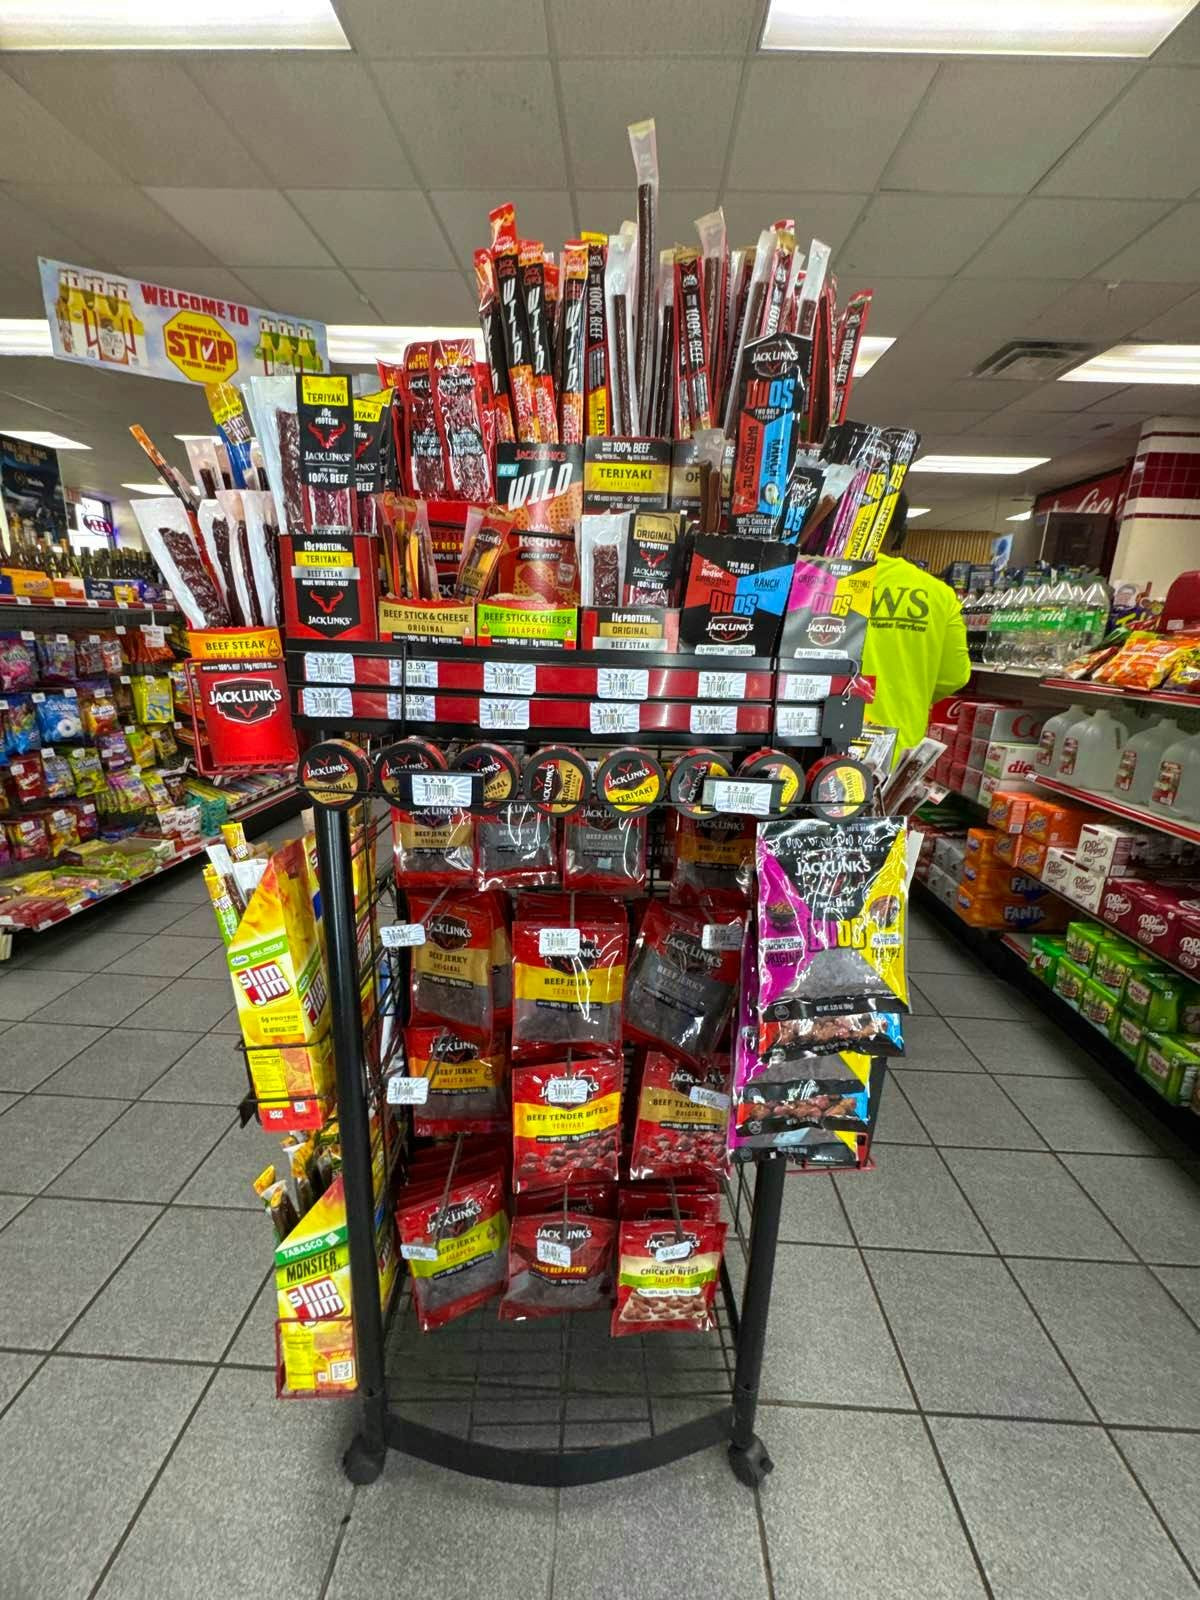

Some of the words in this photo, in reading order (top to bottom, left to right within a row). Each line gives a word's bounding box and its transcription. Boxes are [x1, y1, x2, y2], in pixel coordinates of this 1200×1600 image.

[141, 284, 226, 319] WELCOME
[227, 304, 249, 326] TO
[177, 323, 222, 338] COMPLETE
[589, 316, 603, 339] BEEF
[167, 330, 234, 366] STOP
[689, 340, 704, 365] BEEF
[752, 352, 772, 364] JACK
[307, 392, 345, 404] TERIYAKI
[355, 411, 376, 420] IYAKI
[613, 442, 631, 454] 100%
[632, 442, 651, 454] BEEF
[308, 473, 329, 484] 100%
[330, 473, 349, 485] BEEF
[600, 467, 652, 480] TERIYAKI
[357, 483, 374, 492] BEEF
[508, 462, 573, 510] WILD
[866, 472, 886, 499] OS
[784, 507, 806, 532] OS
[636, 529, 672, 541] ORIGINAL
[315, 542, 341, 551] PROTEIN
[646, 542, 669, 551] PROTEIN
[306, 555, 341, 564] TERIYAKI
[740, 561, 755, 570] BOLD
[651, 581, 664, 589] BEEF
[754, 577, 780, 589] RANCH
[710, 588, 759, 616] DUOS
[811, 592, 853, 617] DUOS
[870, 586, 930, 619] WS
[308, 615, 327, 625] JACK
[383, 608, 402, 618] BEEF
[404, 610, 428, 620] STICK
[429, 612, 436, 620] &
[437, 613, 469, 622] CHEESE
[484, 612, 504, 620] BEEF
[506, 613, 531, 622] STICK
[531, 615, 538, 623] &
[540, 615, 572, 624] CHEESE
[623, 613, 651, 623] PROTEIN
[407, 623, 444, 633] ORIGINAL
[612, 626, 649, 635] ORIGINAL
[706, 621, 728, 631] JACK
[806, 623, 825, 633] JACK
[205, 641, 231, 651] BEEF
[231, 640, 266, 649] STEAK
[611, 640, 627, 649] BEEF
[629, 640, 650, 649] STEAK
[407, 661, 426, 670] 3.59
[209, 690, 242, 705] JACK
[406, 695, 425, 703] 3.59
[307, 767, 326, 778] JACK
[608, 775, 628, 789] JACK
[616, 787, 654, 803] TERIYAKI
[582, 808, 602, 818] JACK
[663, 934, 689, 953] JACK
[444, 953, 468, 963] JERKY
[238, 963, 286, 990] slim
[544, 977, 566, 985] BEEF
[678, 972, 705, 992] JERKY
[669, 1072, 694, 1084] JACK
[653, 1098, 671, 1106] BEEF
[549, 1113, 583, 1121] TENDER
[585, 1106, 609, 1118] BITES
[535, 1228, 561, 1241] JACK
[456, 1233, 482, 1249] JERKY
[281, 1238, 323, 1259] TABASCO
[286, 1250, 337, 1283] MONSTER
[640, 1267, 675, 1276] CHICKEN
[677, 1265, 699, 1276] BITES
[287, 1279, 338, 1309] slim
